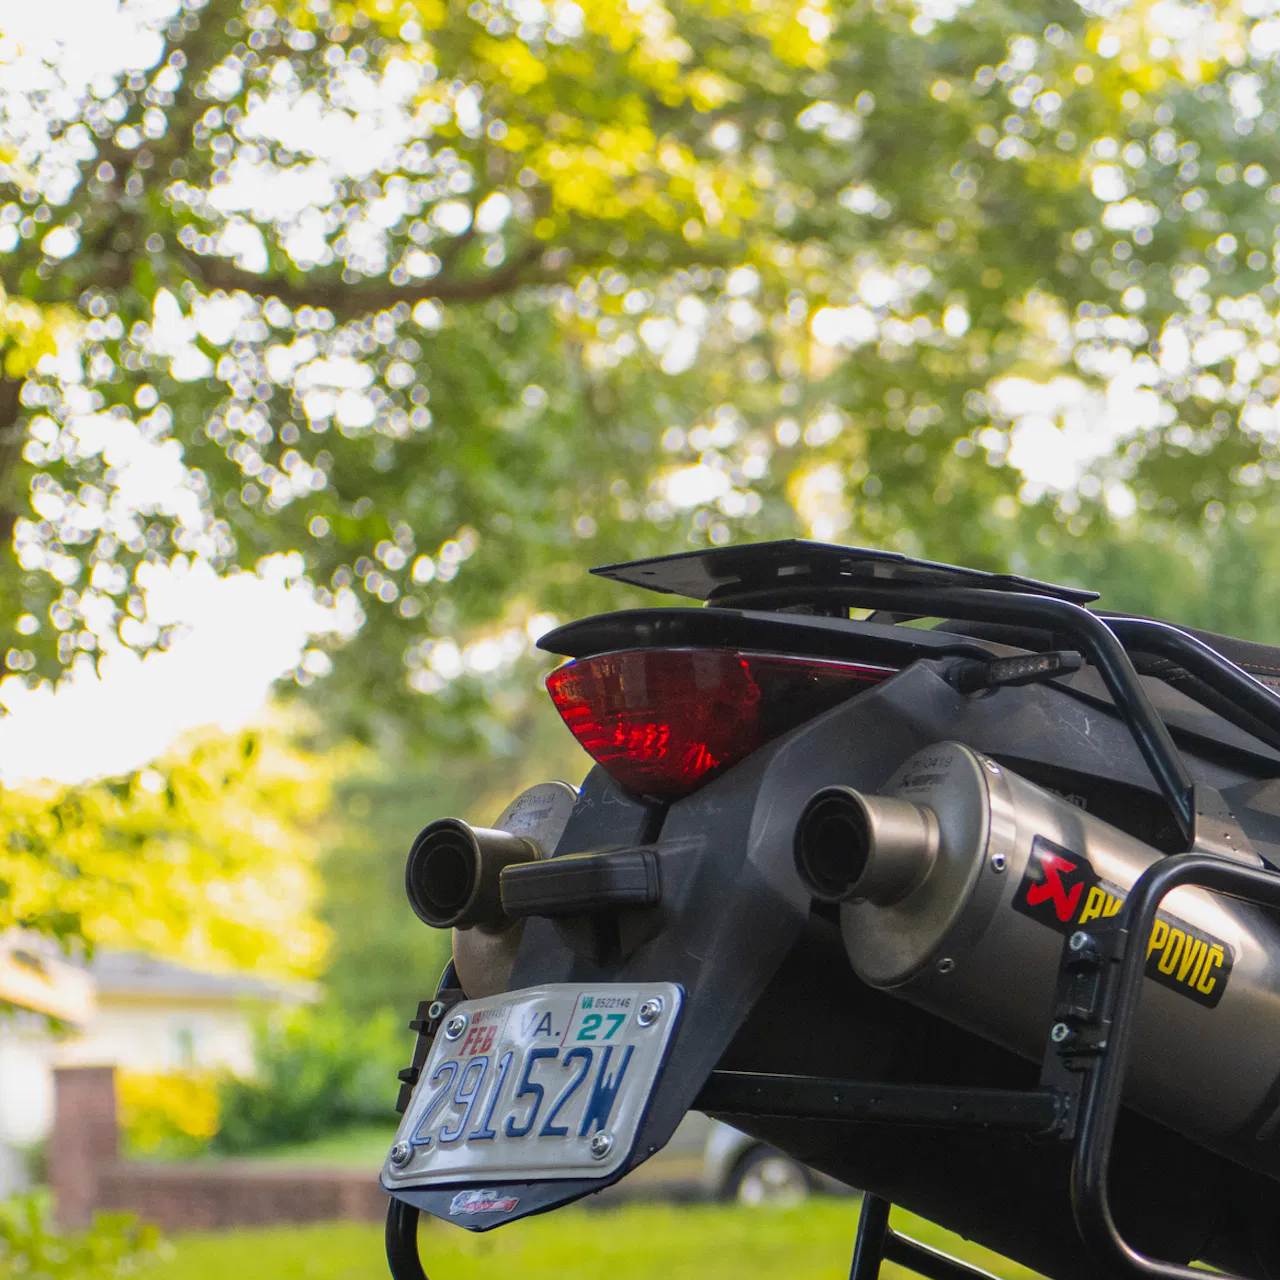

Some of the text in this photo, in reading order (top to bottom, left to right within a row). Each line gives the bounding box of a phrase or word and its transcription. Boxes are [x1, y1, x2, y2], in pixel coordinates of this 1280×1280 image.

[1078, 886, 1225, 995] AKPOVIČ
[458, 1026, 498, 1056] FEB
[576, 1013, 627, 1041] 27
[411, 1045, 635, 1147] 29152W
